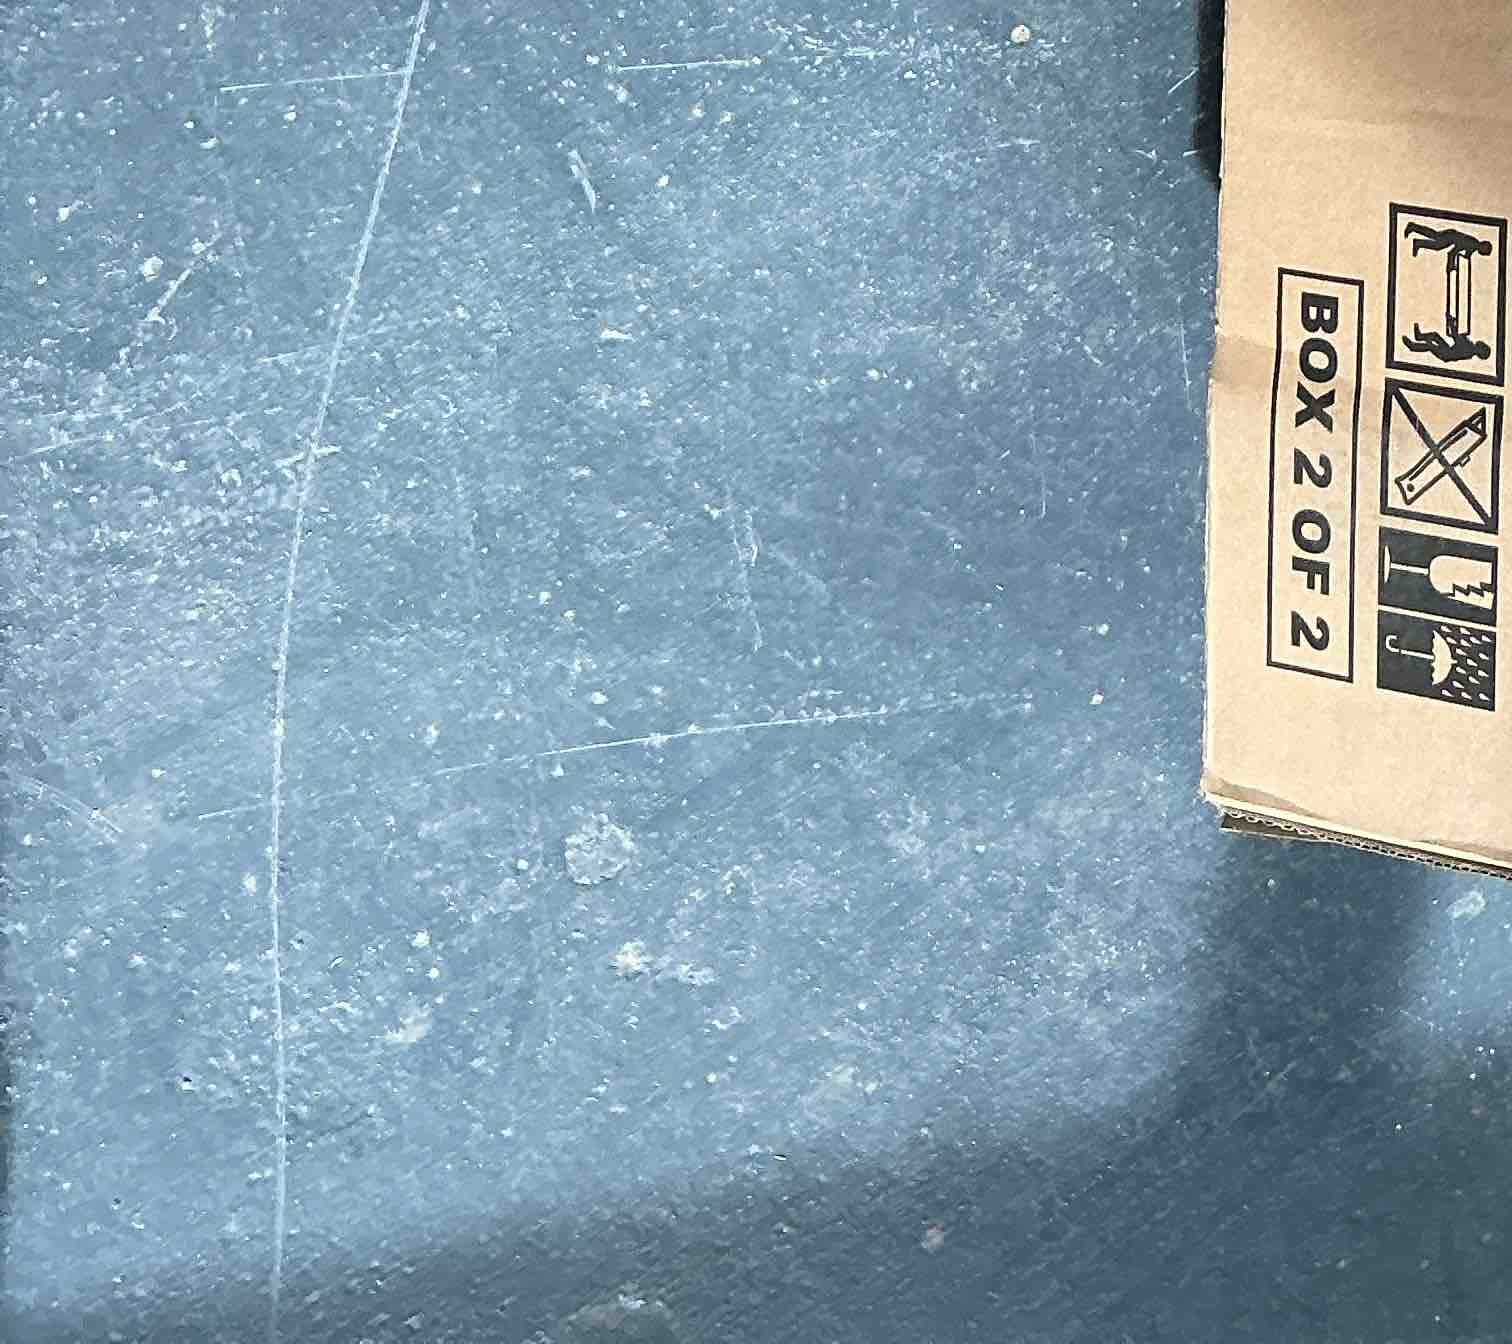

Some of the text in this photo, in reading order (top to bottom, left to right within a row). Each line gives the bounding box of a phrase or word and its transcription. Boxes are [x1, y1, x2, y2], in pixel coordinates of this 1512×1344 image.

[1290, 290, 1339, 652] BOX 2 OF 2
